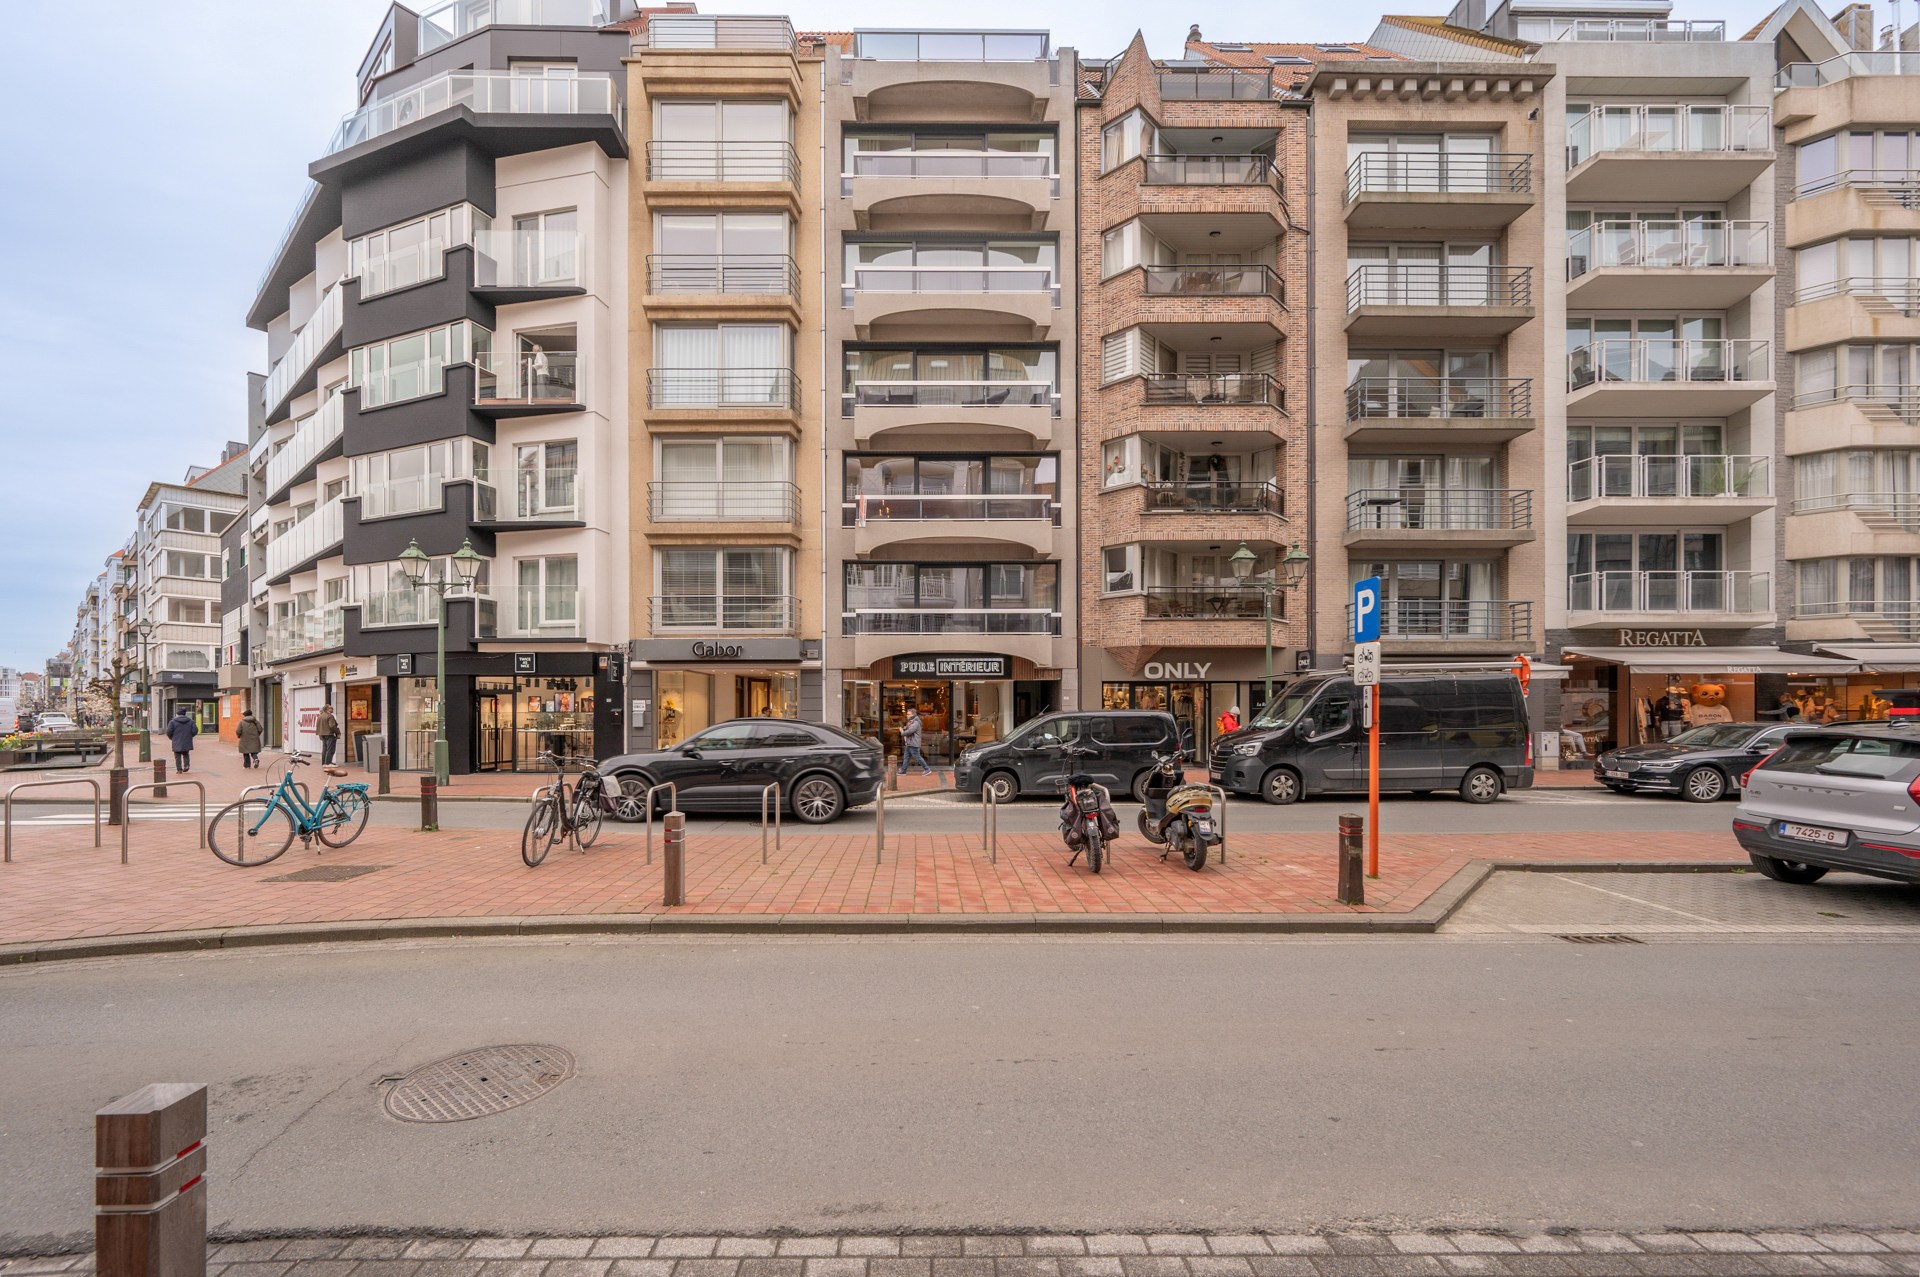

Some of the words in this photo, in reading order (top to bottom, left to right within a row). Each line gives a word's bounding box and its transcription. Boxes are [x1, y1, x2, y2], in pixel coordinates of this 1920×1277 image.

[1357, 588, 1375, 633] P
[1618, 629, 1707, 647] REGATTA
[692, 641, 744, 659] Gabor
[900, 661, 935, 672] PURE
[940, 660, 1000, 672] INTÉRIEUR
[1144, 662, 1212, 679] ONLY
[1727, 665, 1762, 673] REGATTA
